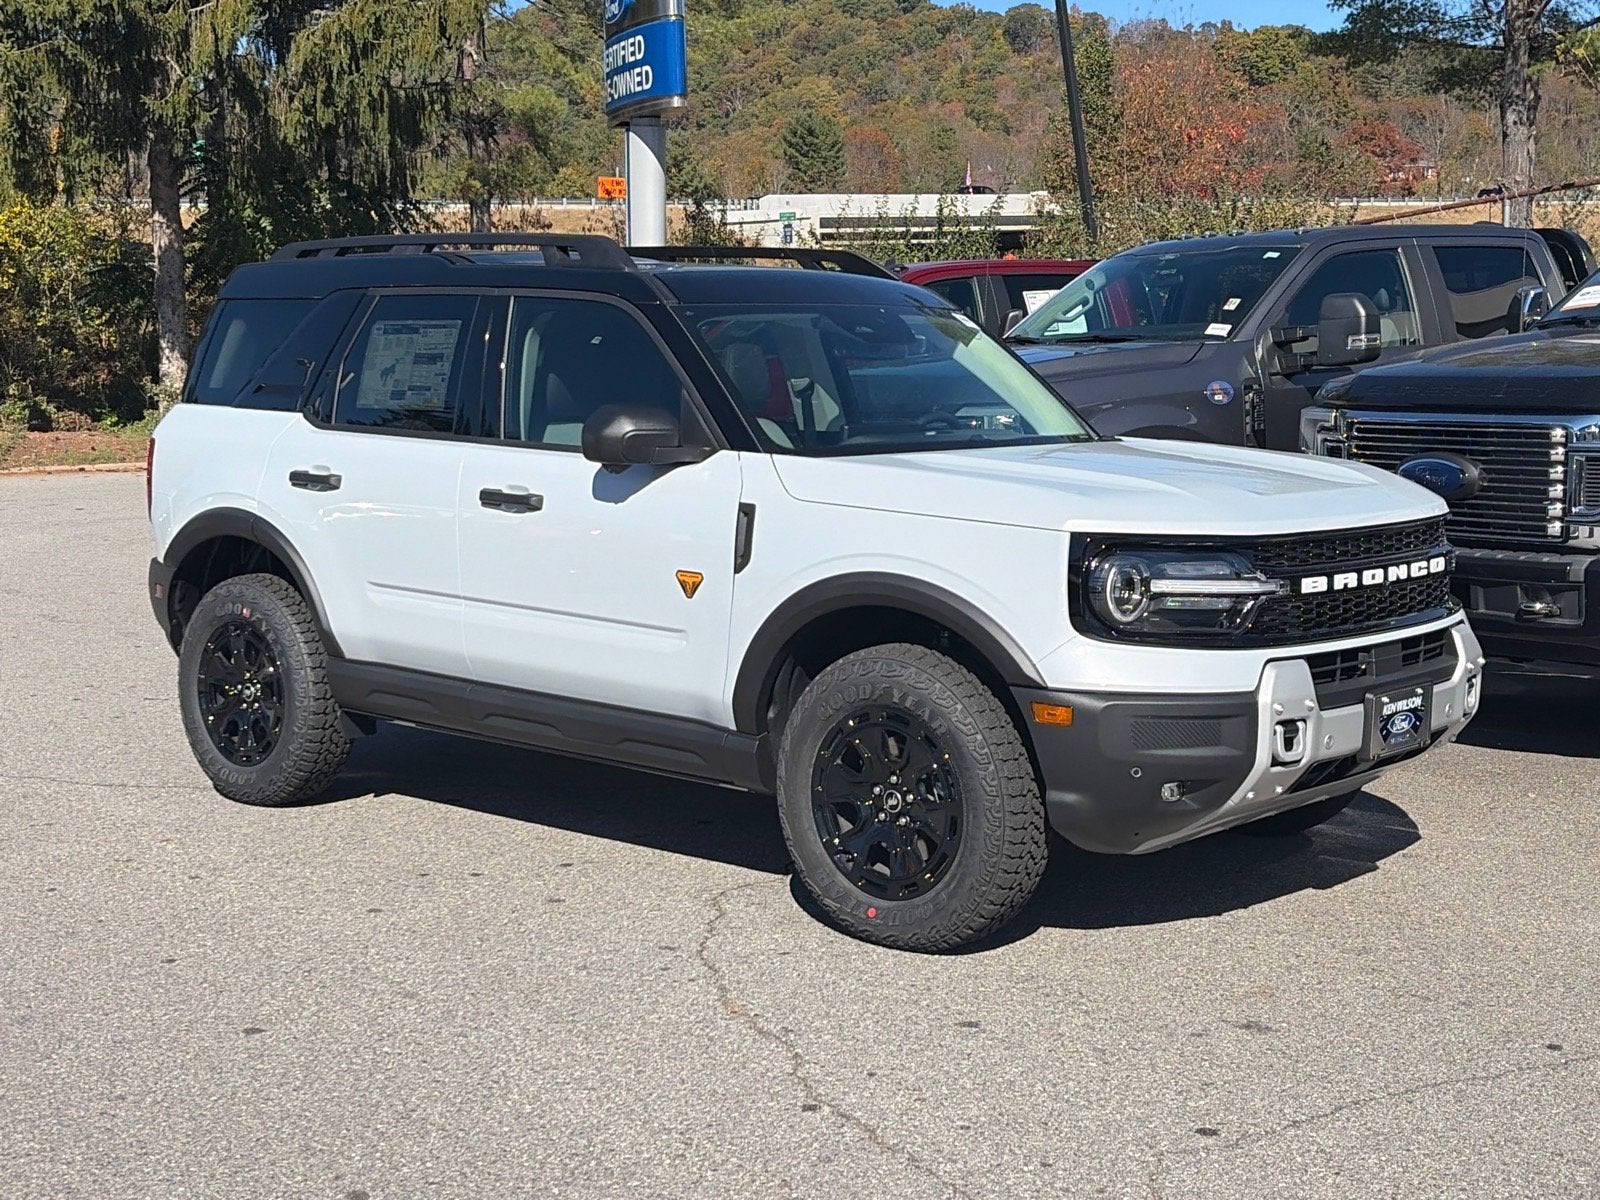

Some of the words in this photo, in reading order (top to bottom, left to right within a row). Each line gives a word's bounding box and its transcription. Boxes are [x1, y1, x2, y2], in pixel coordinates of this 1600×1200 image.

[605, 34, 645, 72] ERTIFIED
[1300, 556, 1446, 594] BRONCO
[1382, 702, 1397, 716] KEN
[1397, 695, 1423, 712] WILSON
[1392, 715, 1411, 732] Ford
